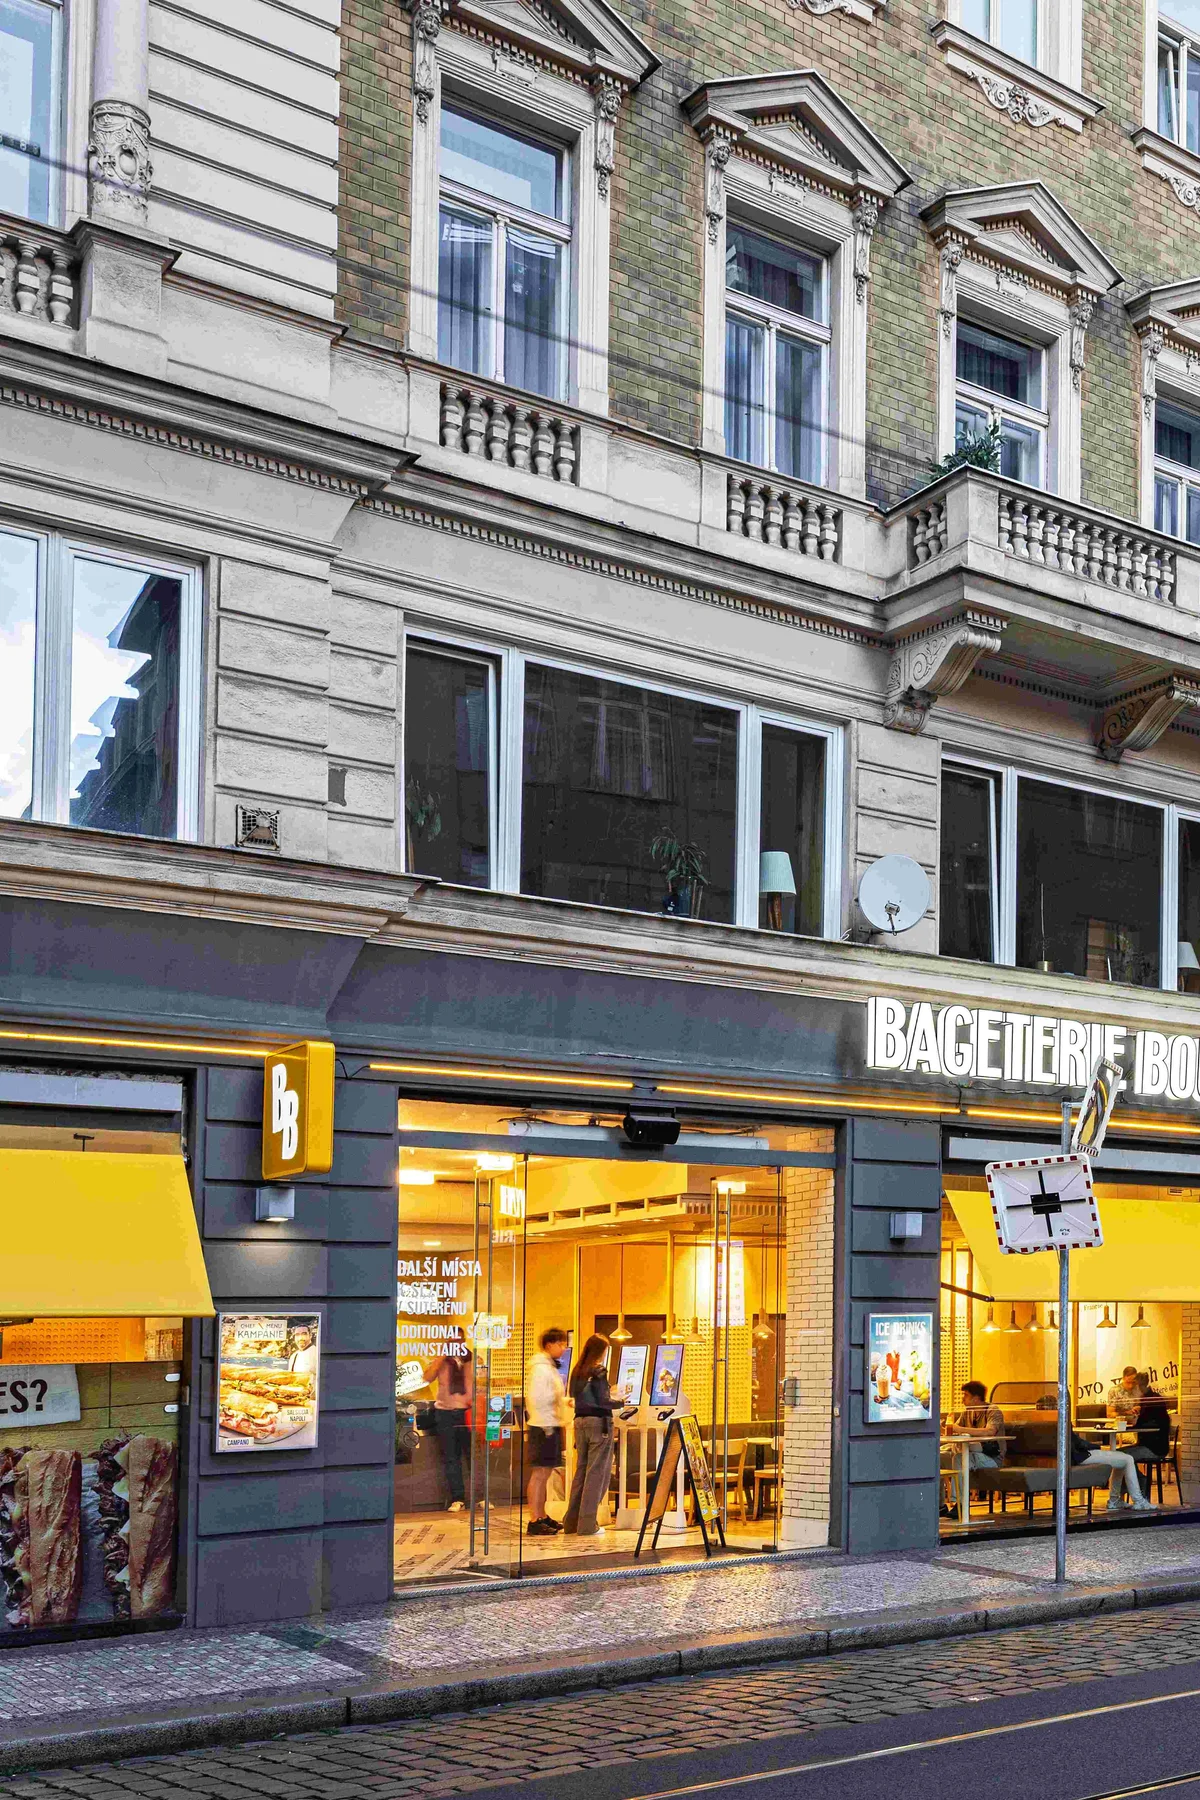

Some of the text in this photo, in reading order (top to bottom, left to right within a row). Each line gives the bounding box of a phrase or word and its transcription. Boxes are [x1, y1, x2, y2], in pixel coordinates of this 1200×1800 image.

[867, 996, 1127, 1091] BAGETERIE
[272, 1063, 299, 1160] BB
[397, 1256, 482, 1277] DALŠÍ MÍSTA
[411, 1278, 457, 1298] SEZENÍ
[407, 1298, 467, 1315] SUTERÉNU
[875, 1322, 926, 1336] ICE DRINKS
